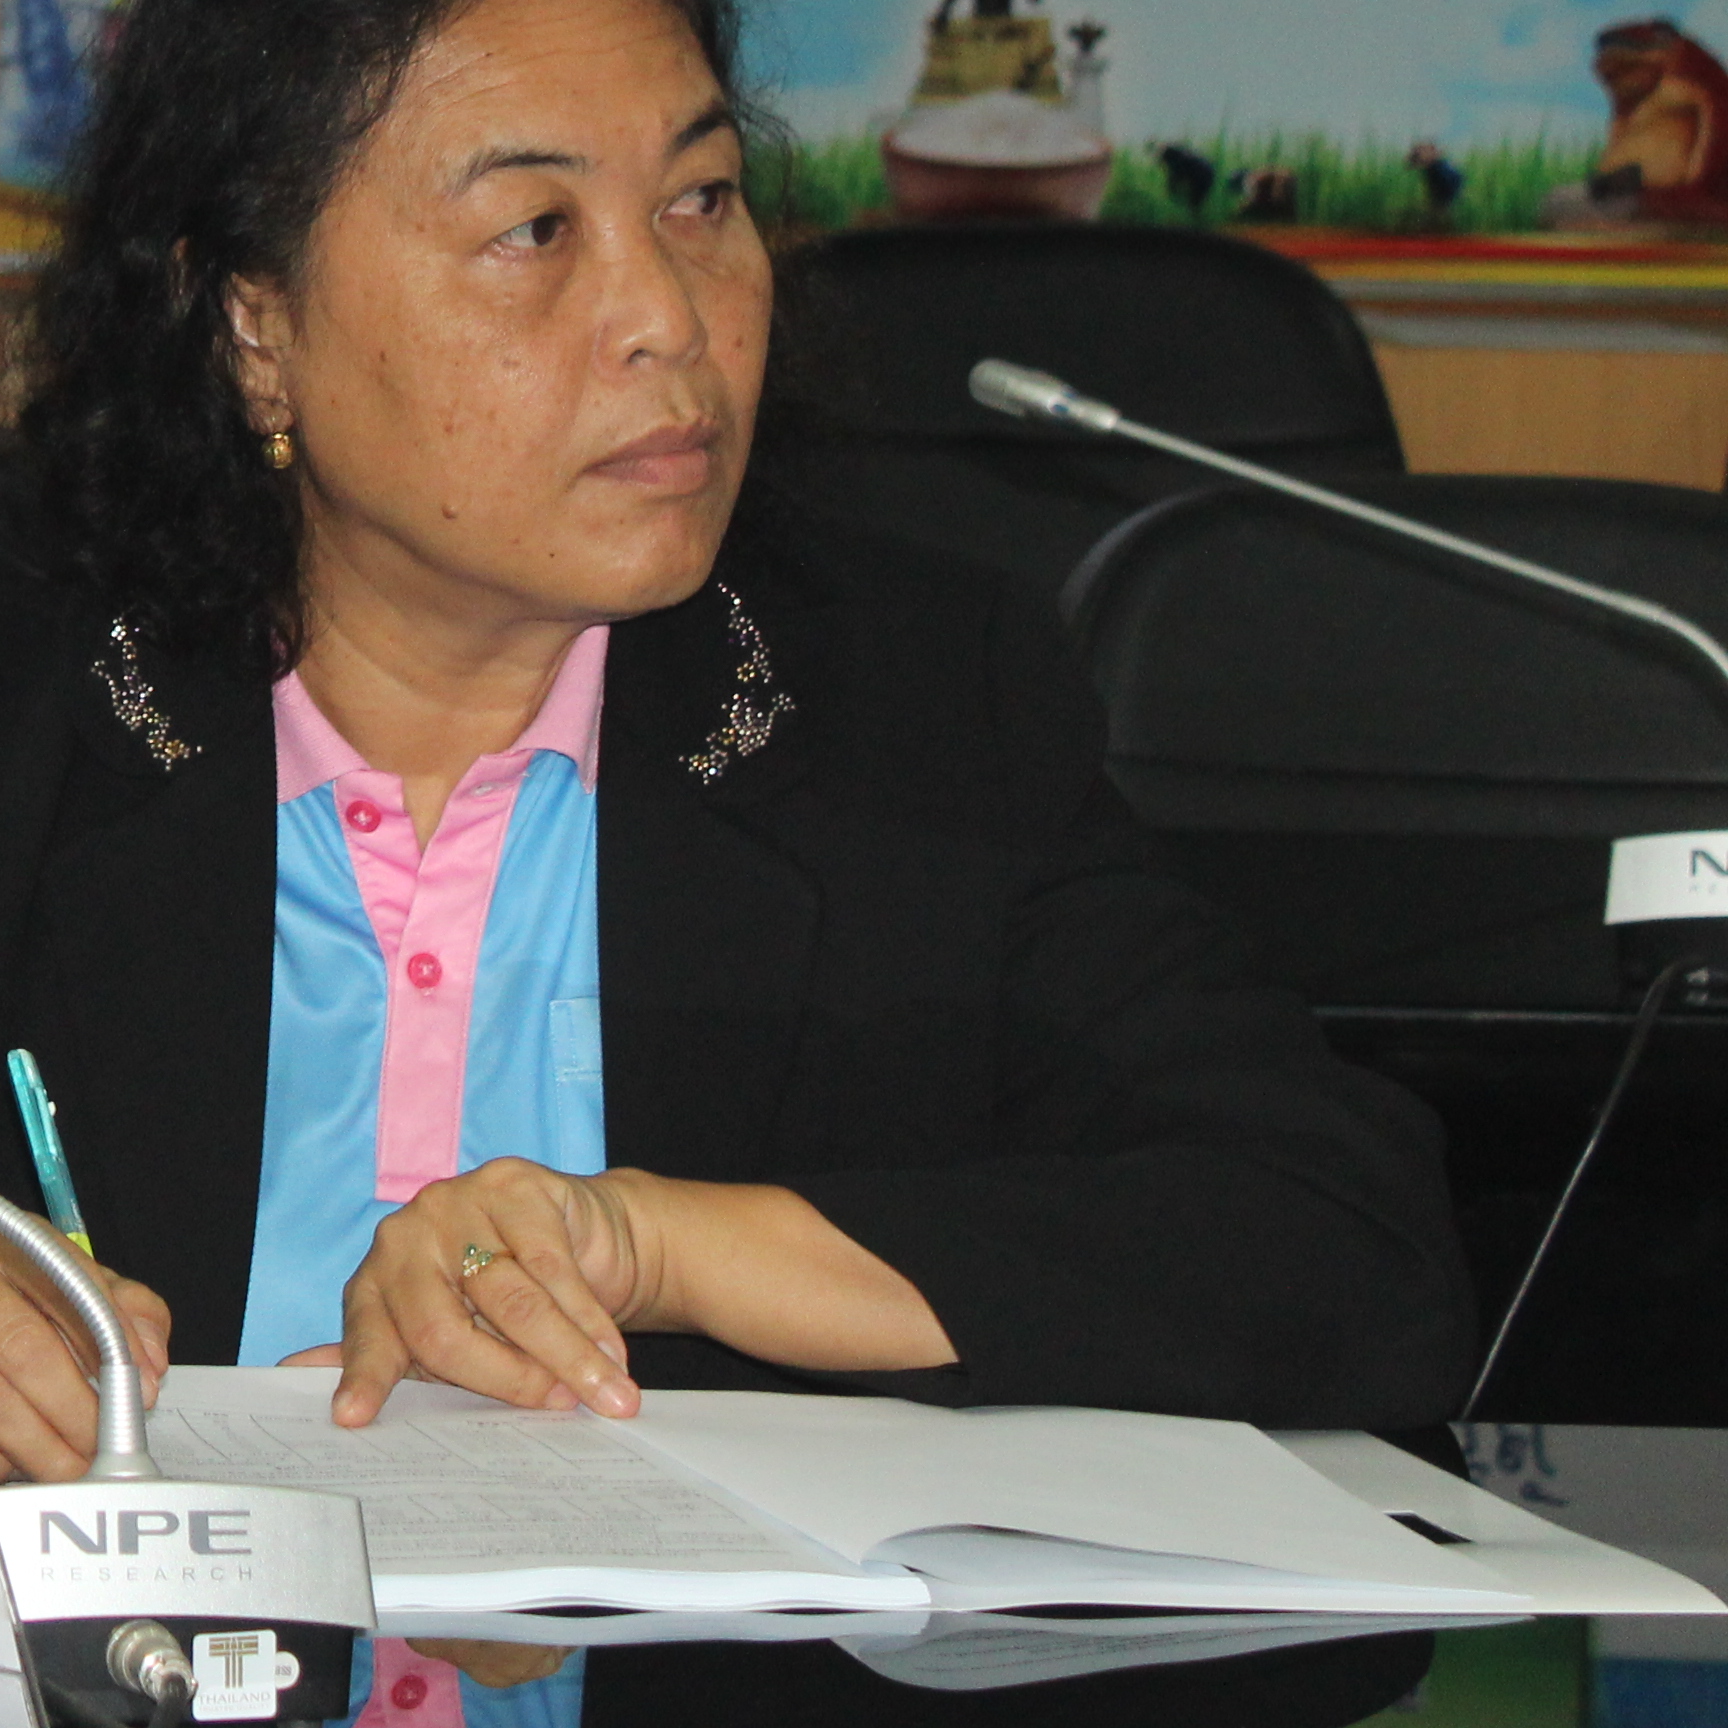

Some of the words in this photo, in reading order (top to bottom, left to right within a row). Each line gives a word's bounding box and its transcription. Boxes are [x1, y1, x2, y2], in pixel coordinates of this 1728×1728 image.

[39, 1510, 253, 1555] NPE
[40, 1565, 253, 1582] RESEARCH
[198, 1691, 271, 1706] THAILAND
